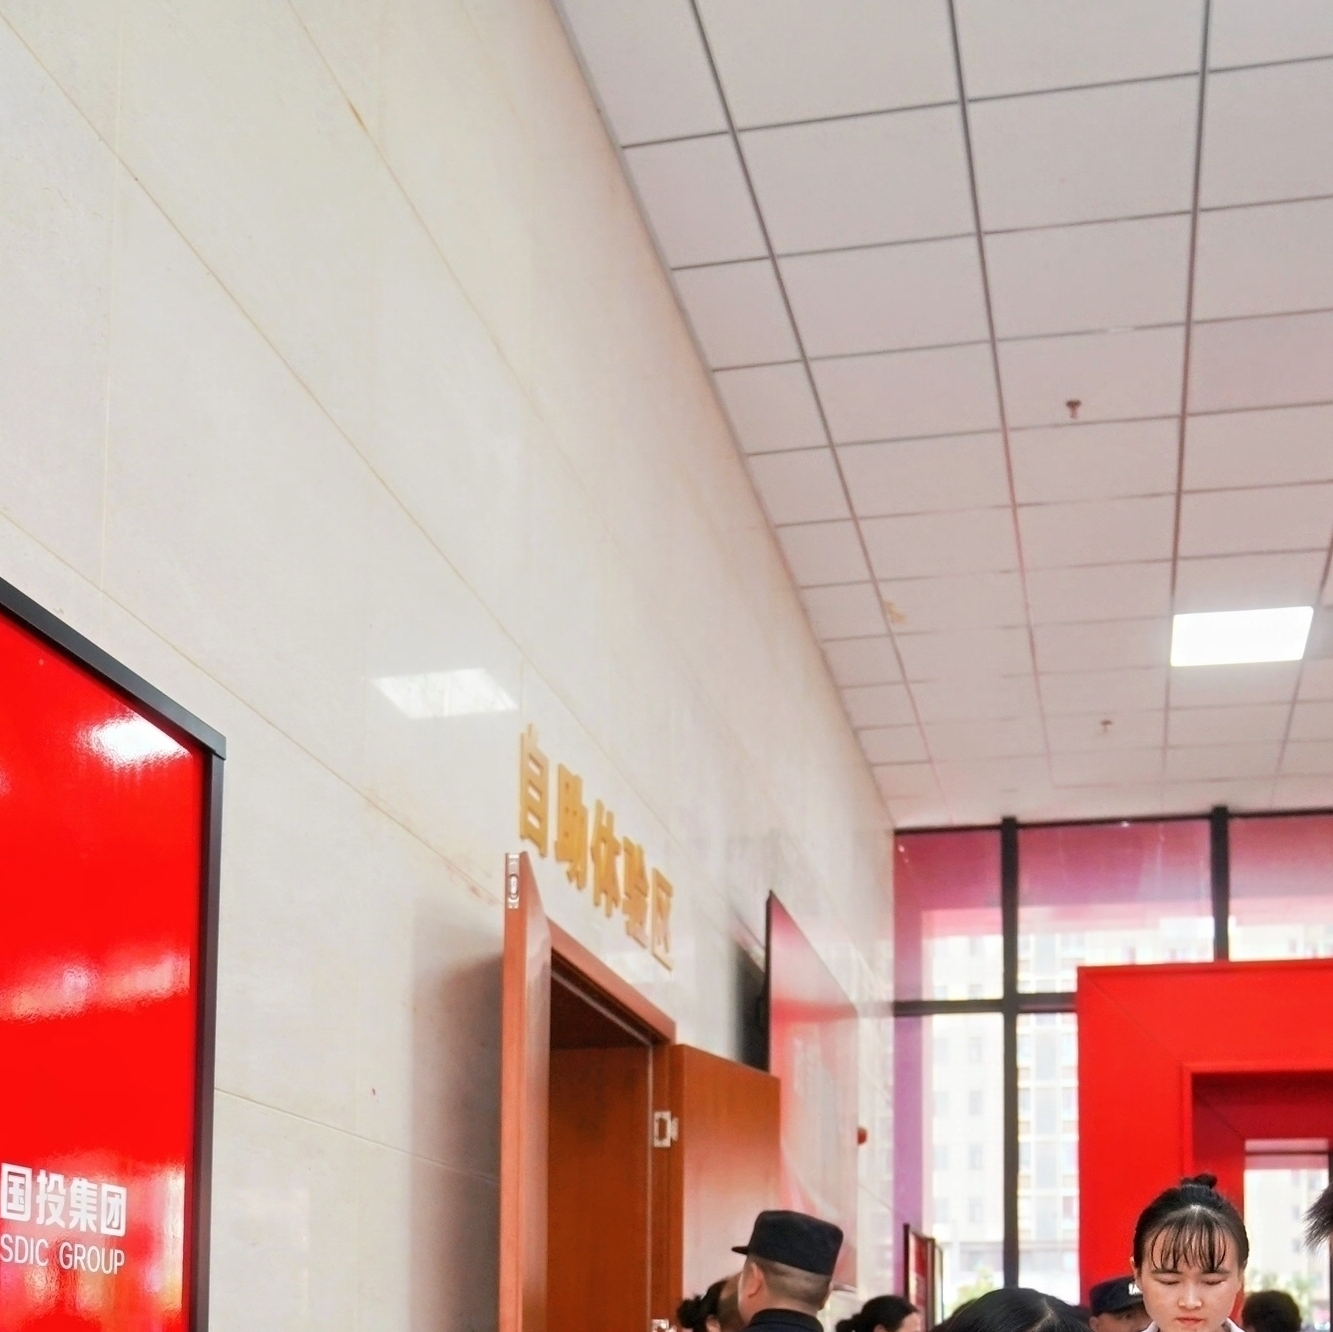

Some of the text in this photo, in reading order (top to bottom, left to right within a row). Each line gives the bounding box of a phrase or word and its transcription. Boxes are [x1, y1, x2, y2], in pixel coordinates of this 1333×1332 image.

[0, 1162, 127, 1237] 国投集团
[0, 1233, 125, 1276] SDIC GROUP
